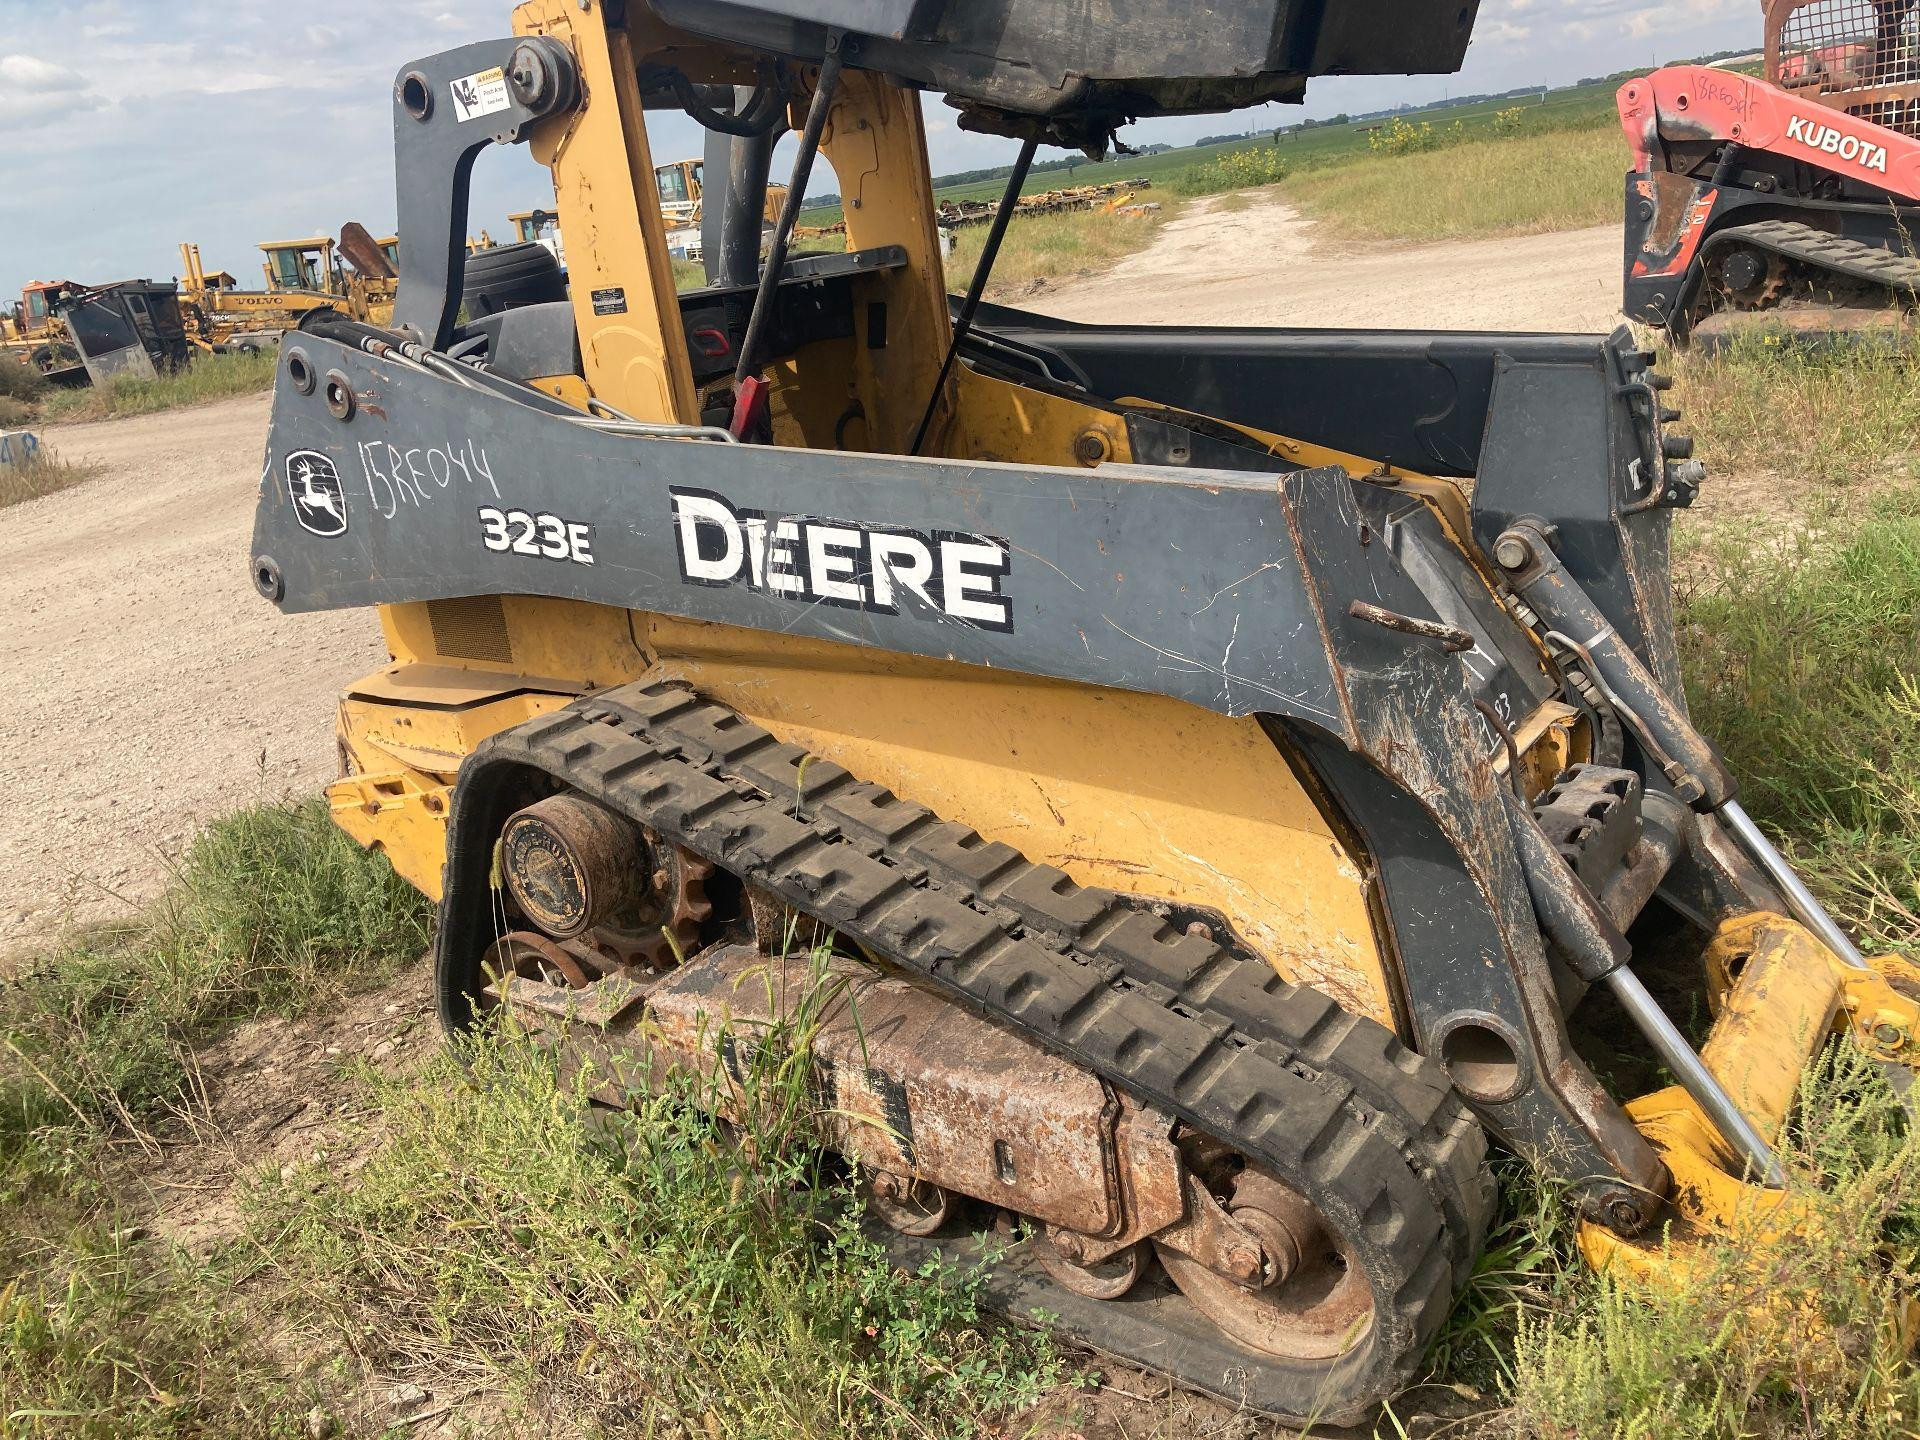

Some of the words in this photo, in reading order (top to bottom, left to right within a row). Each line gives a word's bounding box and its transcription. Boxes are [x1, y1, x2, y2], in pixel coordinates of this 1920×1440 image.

[1785, 115, 1887, 173] KUBOTA
[235, 297, 283, 305] VOLVO
[479, 508, 594, 564] 323E
[672, 493, 1007, 623] DEERE
